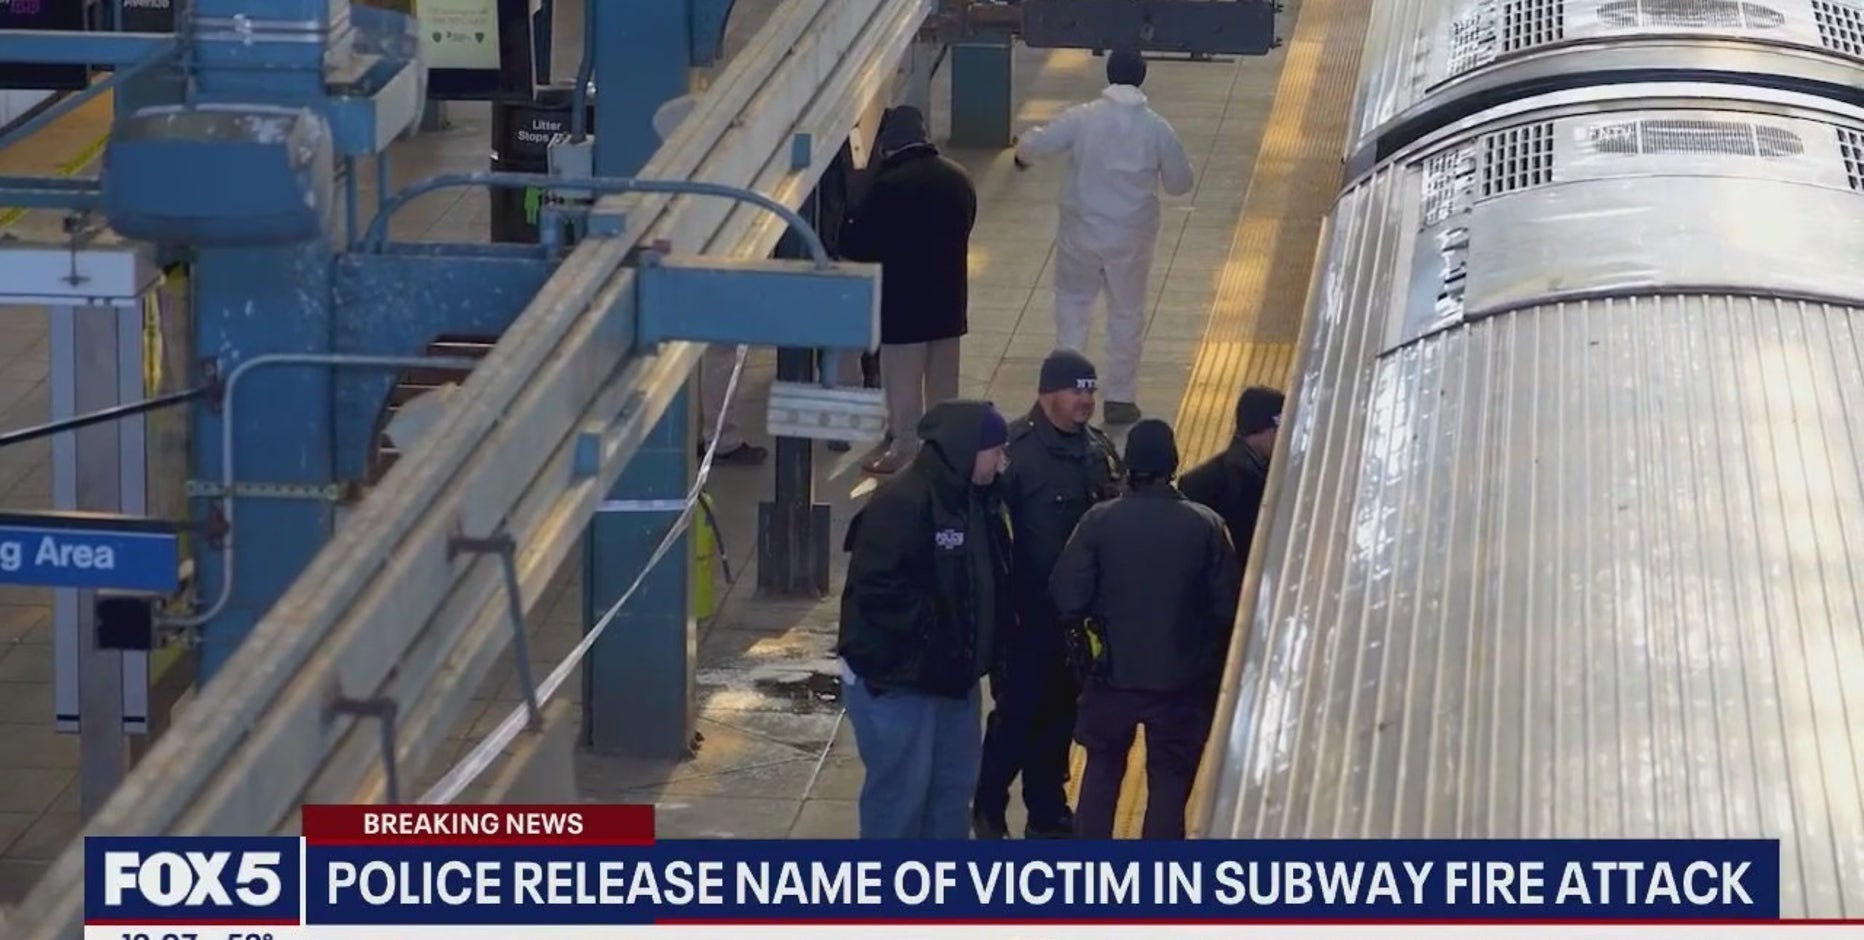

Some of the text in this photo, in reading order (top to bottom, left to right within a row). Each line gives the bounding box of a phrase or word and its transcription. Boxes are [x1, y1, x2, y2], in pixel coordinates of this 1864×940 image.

[532, 120, 562, 131] Litter
[517, 130, 550, 143] Stops
[34, 535, 115, 569] Area
